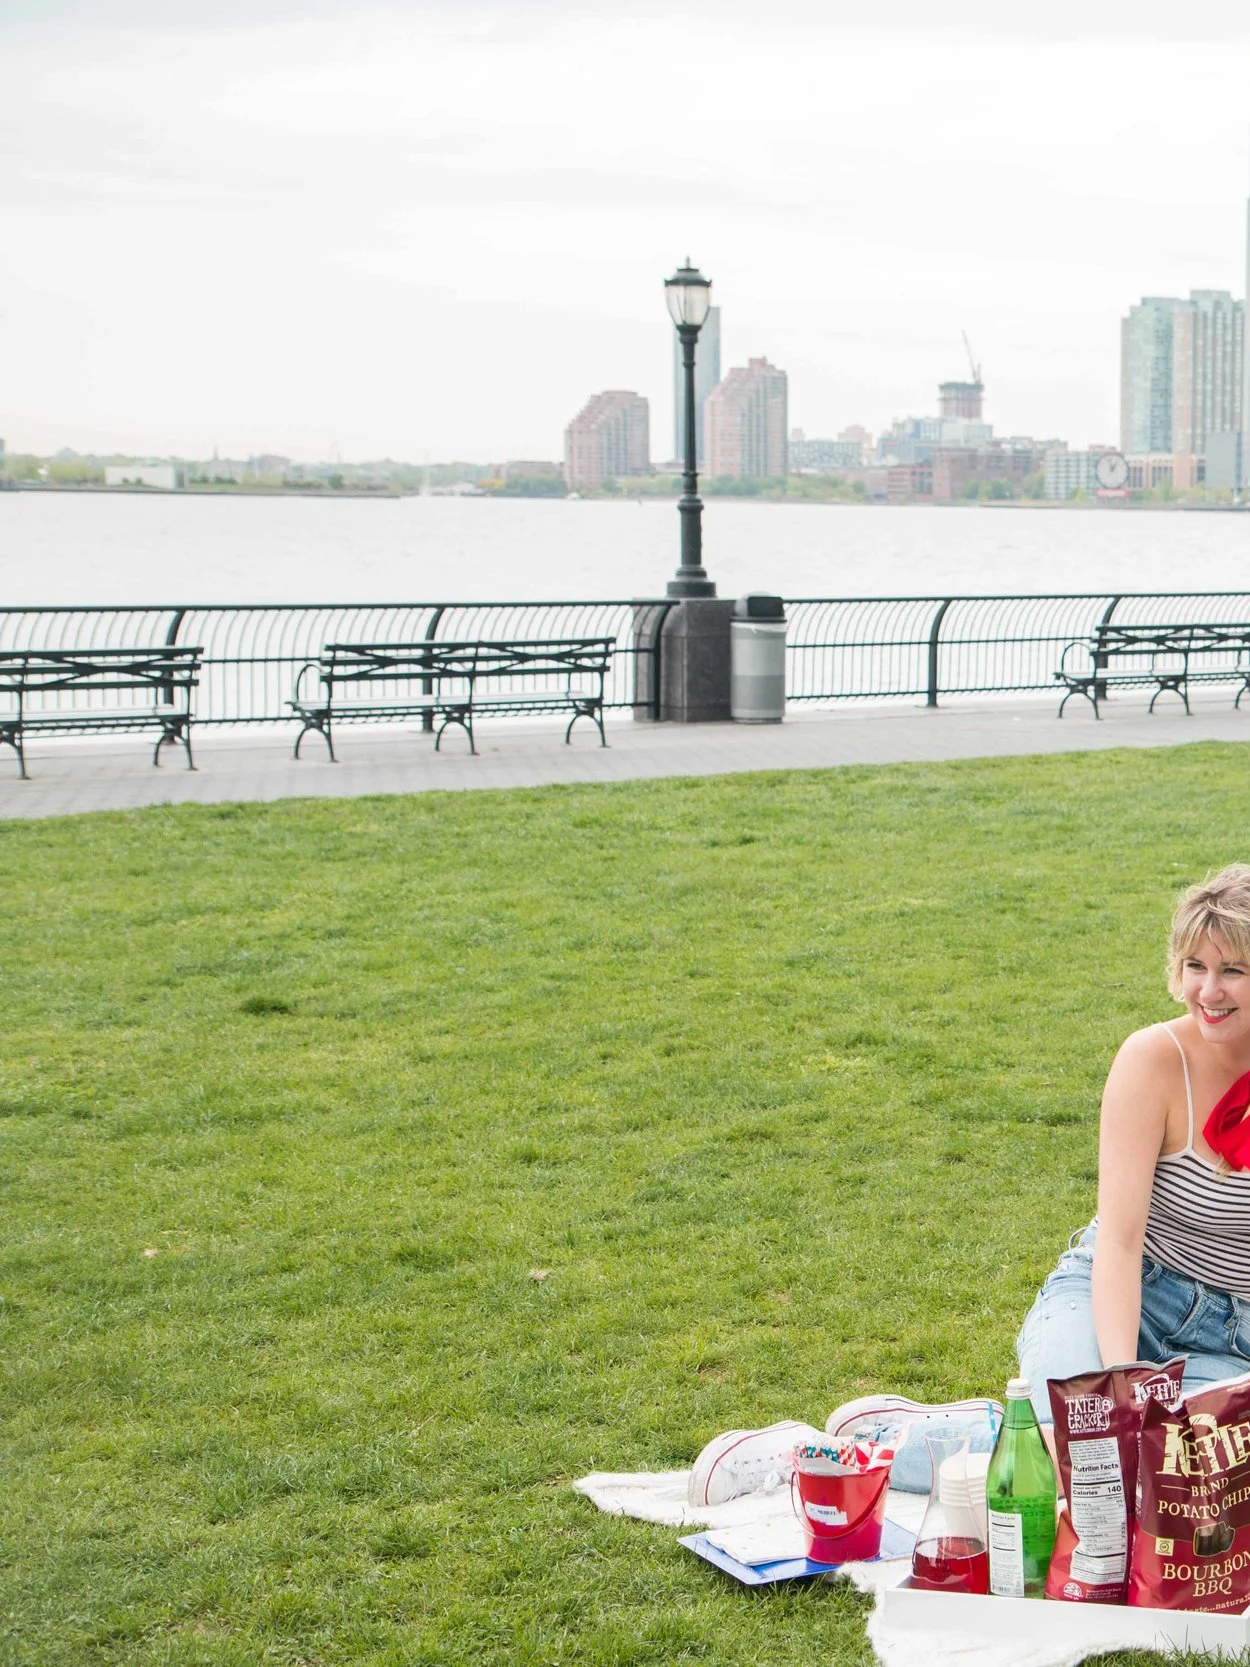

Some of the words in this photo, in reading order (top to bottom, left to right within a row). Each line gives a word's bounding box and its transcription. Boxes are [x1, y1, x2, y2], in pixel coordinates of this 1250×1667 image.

[1065, 1397, 1101, 1414] TATER
[1107, 1485, 1122, 1493] 140
[1157, 1500, 1220, 1519] POTATO
[1193, 1577, 1232, 1597] BBQ
